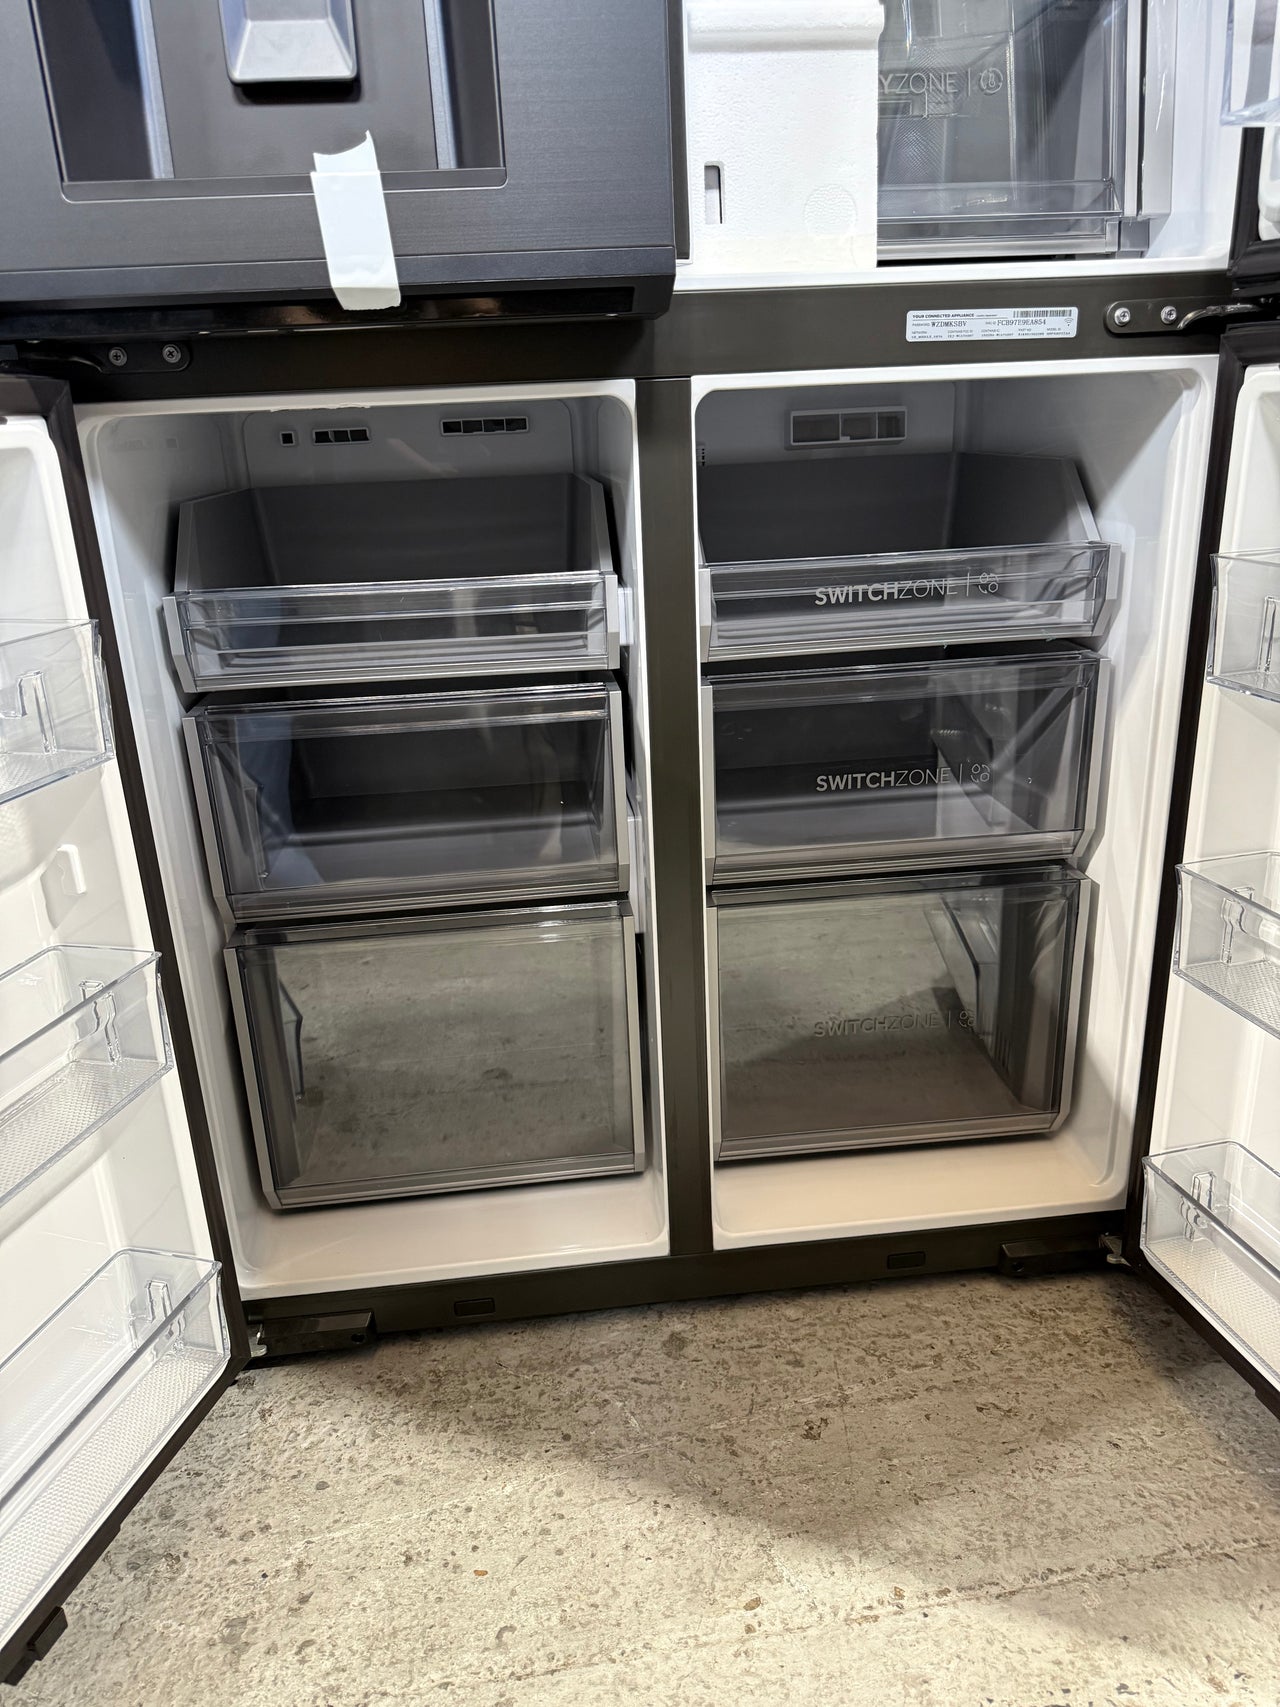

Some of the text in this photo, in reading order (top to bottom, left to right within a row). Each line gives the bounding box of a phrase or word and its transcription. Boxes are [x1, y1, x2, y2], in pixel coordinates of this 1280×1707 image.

[814, 578, 958, 606] SWITCHZONE
[816, 767, 951, 792] SWITCHZONE
[814, 1011, 938, 1037] SWITCHZONE
